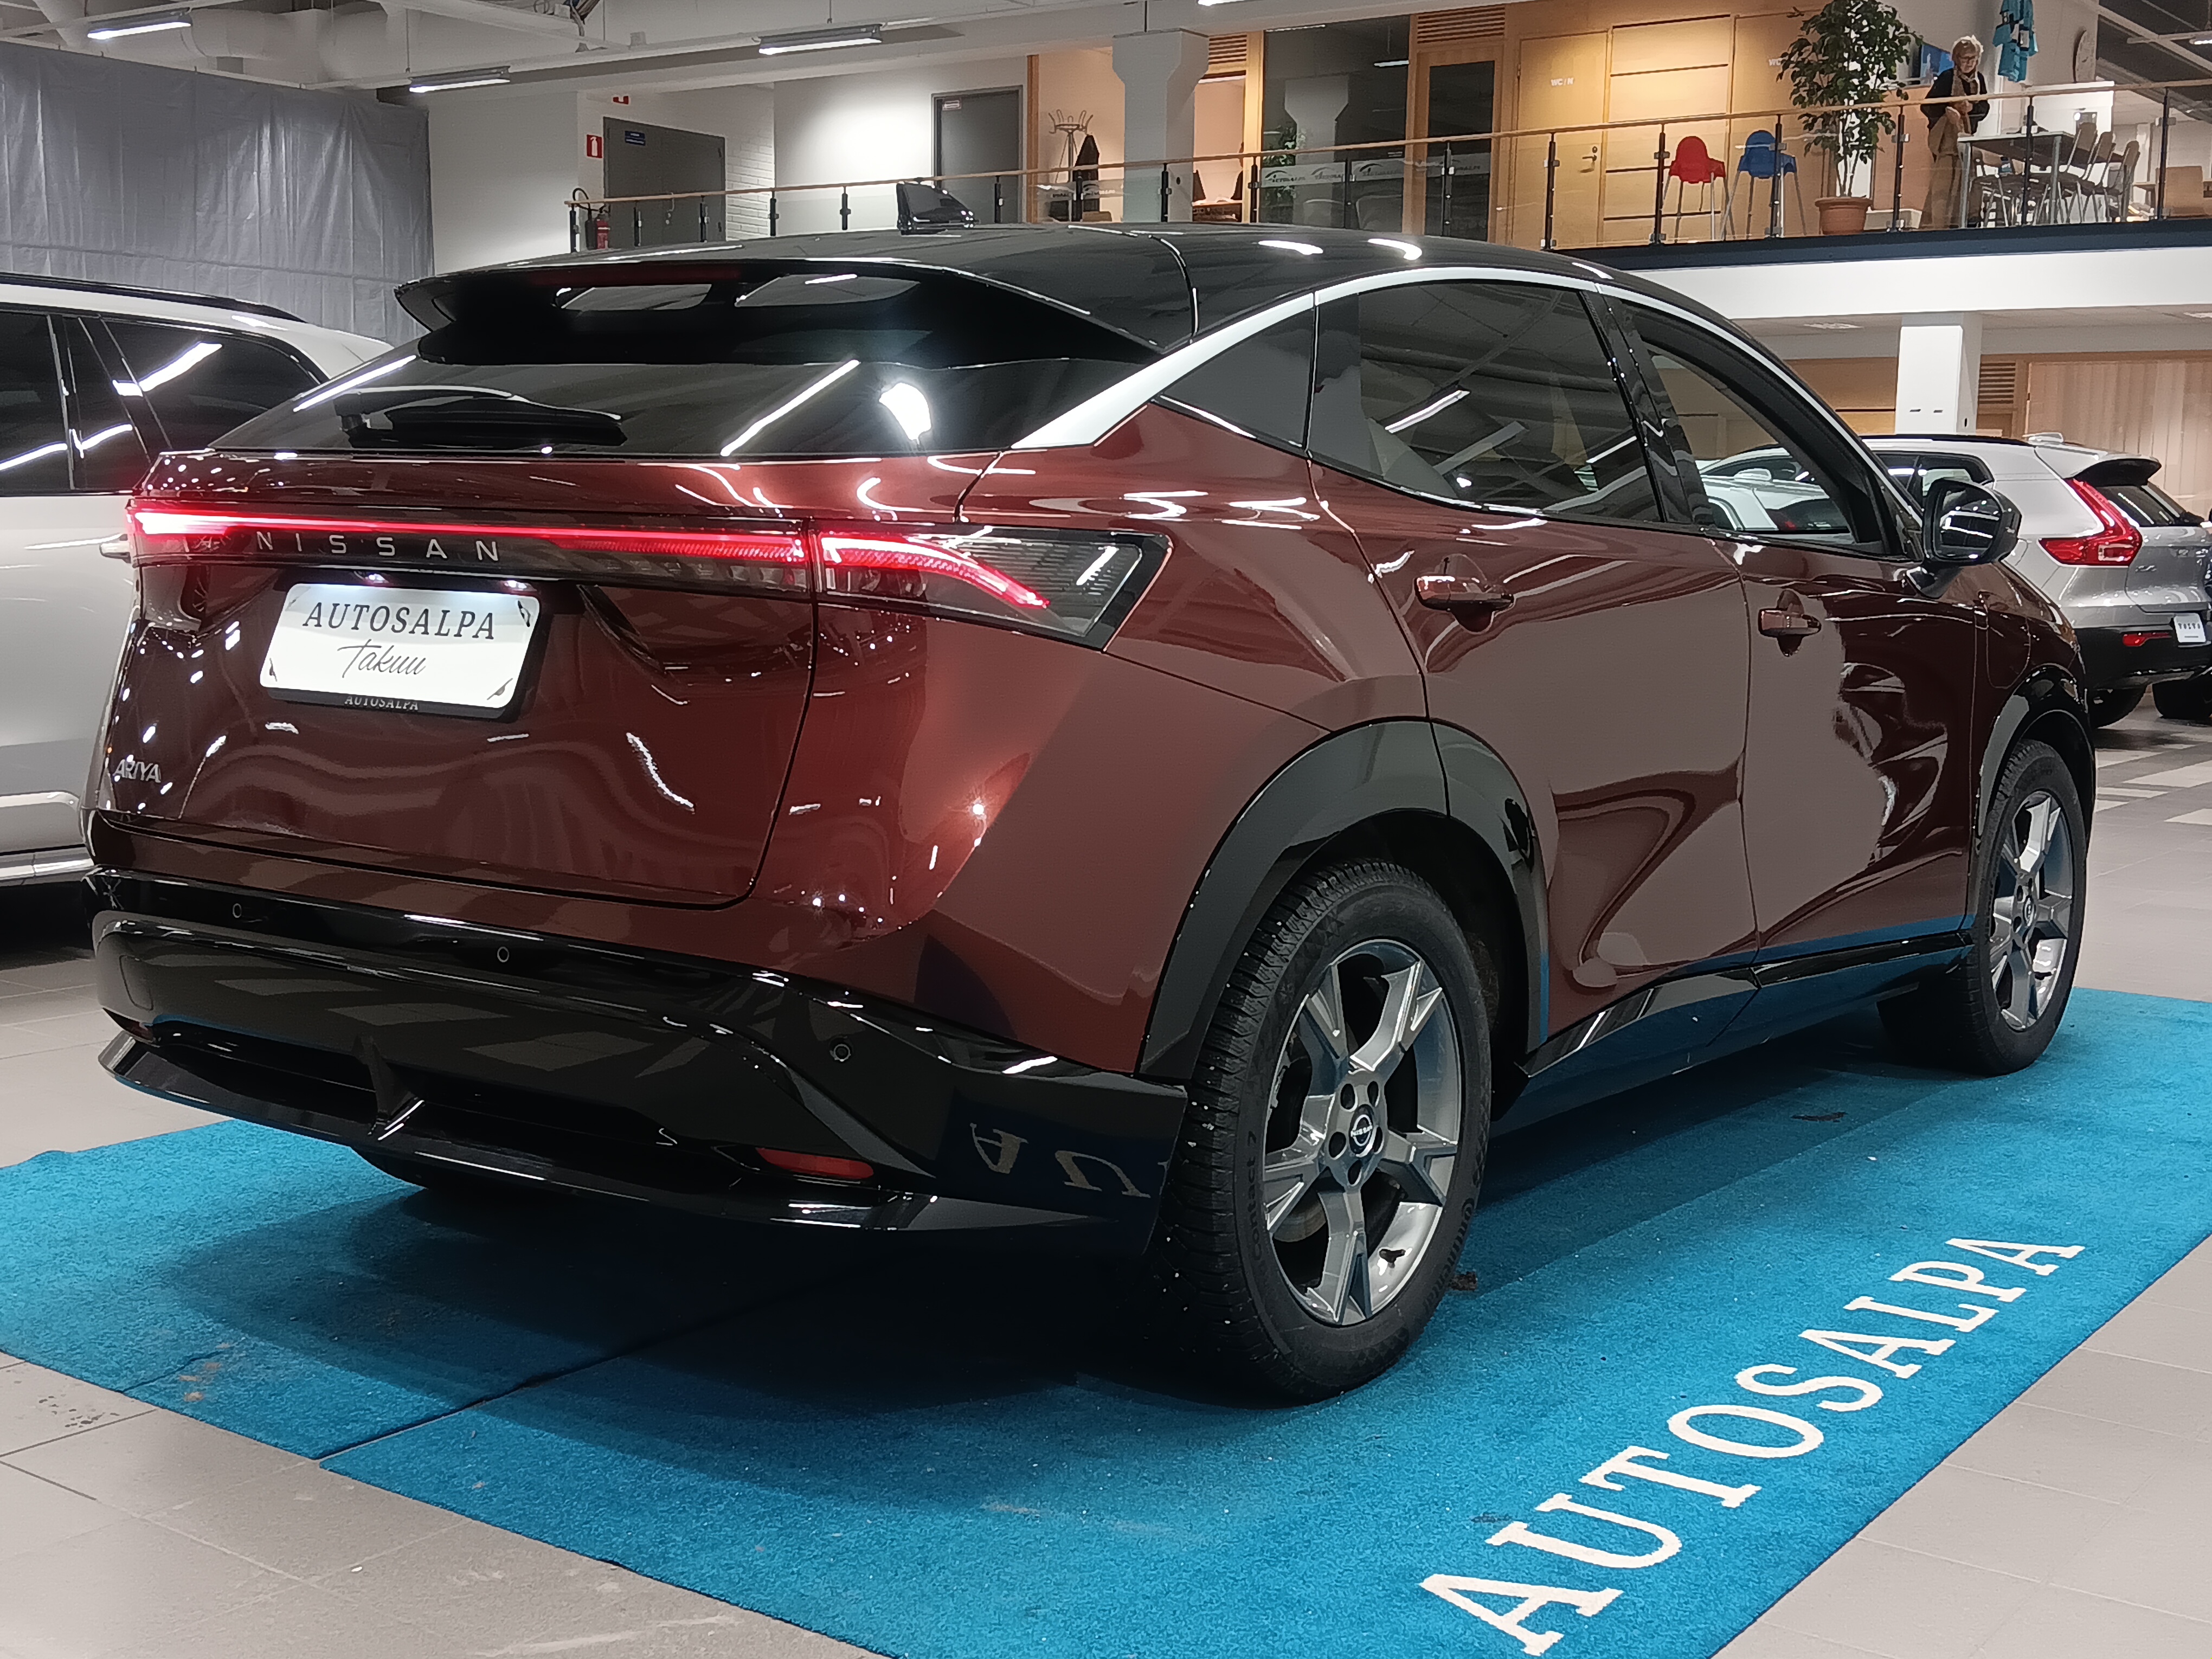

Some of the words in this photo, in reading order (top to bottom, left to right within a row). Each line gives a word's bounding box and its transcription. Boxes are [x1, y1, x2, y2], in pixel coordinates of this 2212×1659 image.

[256, 531, 499, 561] NISSAN
[302, 602, 495, 640] AUTOSALPA
[337, 639, 427, 678] Takuu
[112, 759, 162, 783] ARIYA
[1418, 1237, 2086, 1656] AUTOSALPA
